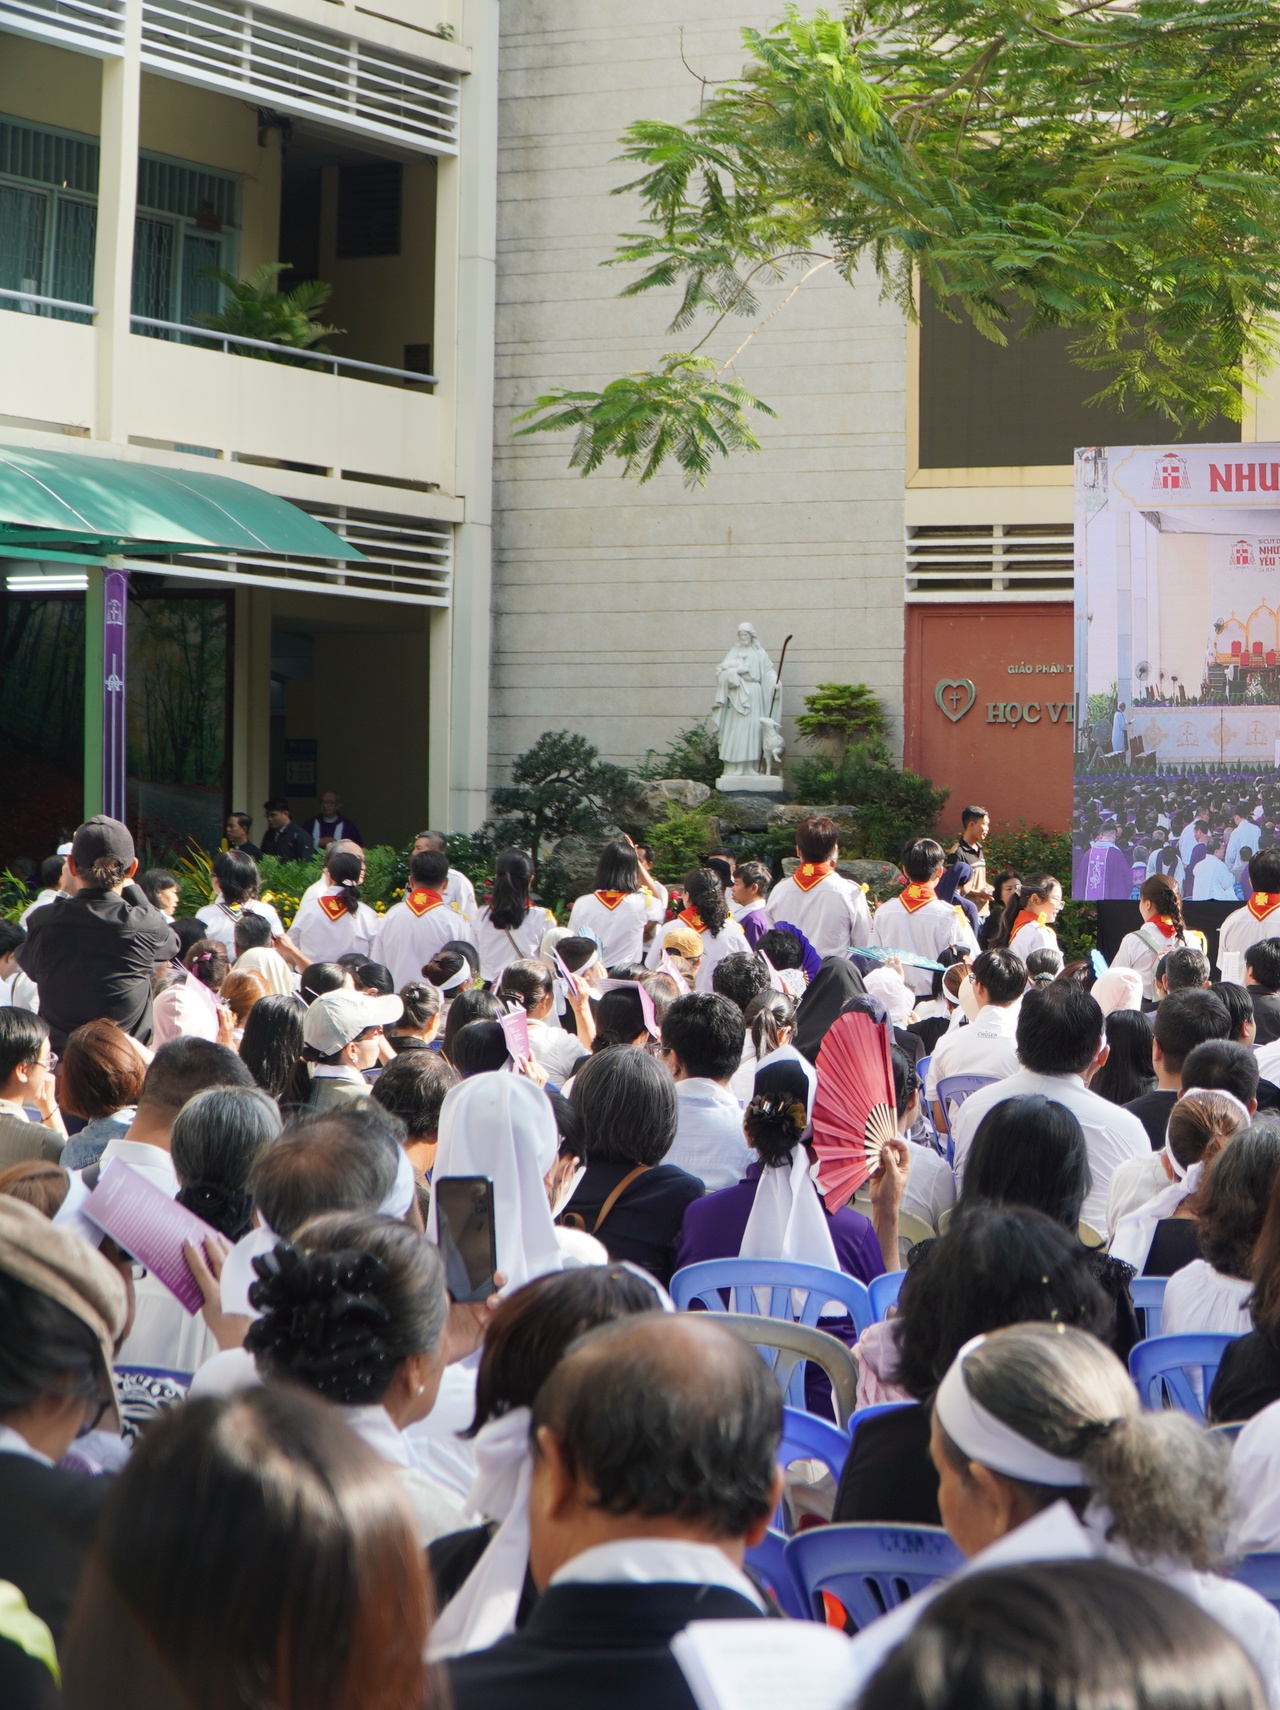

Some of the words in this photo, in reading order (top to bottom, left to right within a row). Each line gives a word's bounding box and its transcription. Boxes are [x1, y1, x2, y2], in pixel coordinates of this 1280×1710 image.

[1259, 545, 1280, 555] NHƯ
[1007, 661, 1033, 674] GIÁO
[1035, 662, 1065, 676] PHẬN
[986, 702, 1041, 728] HỌC
